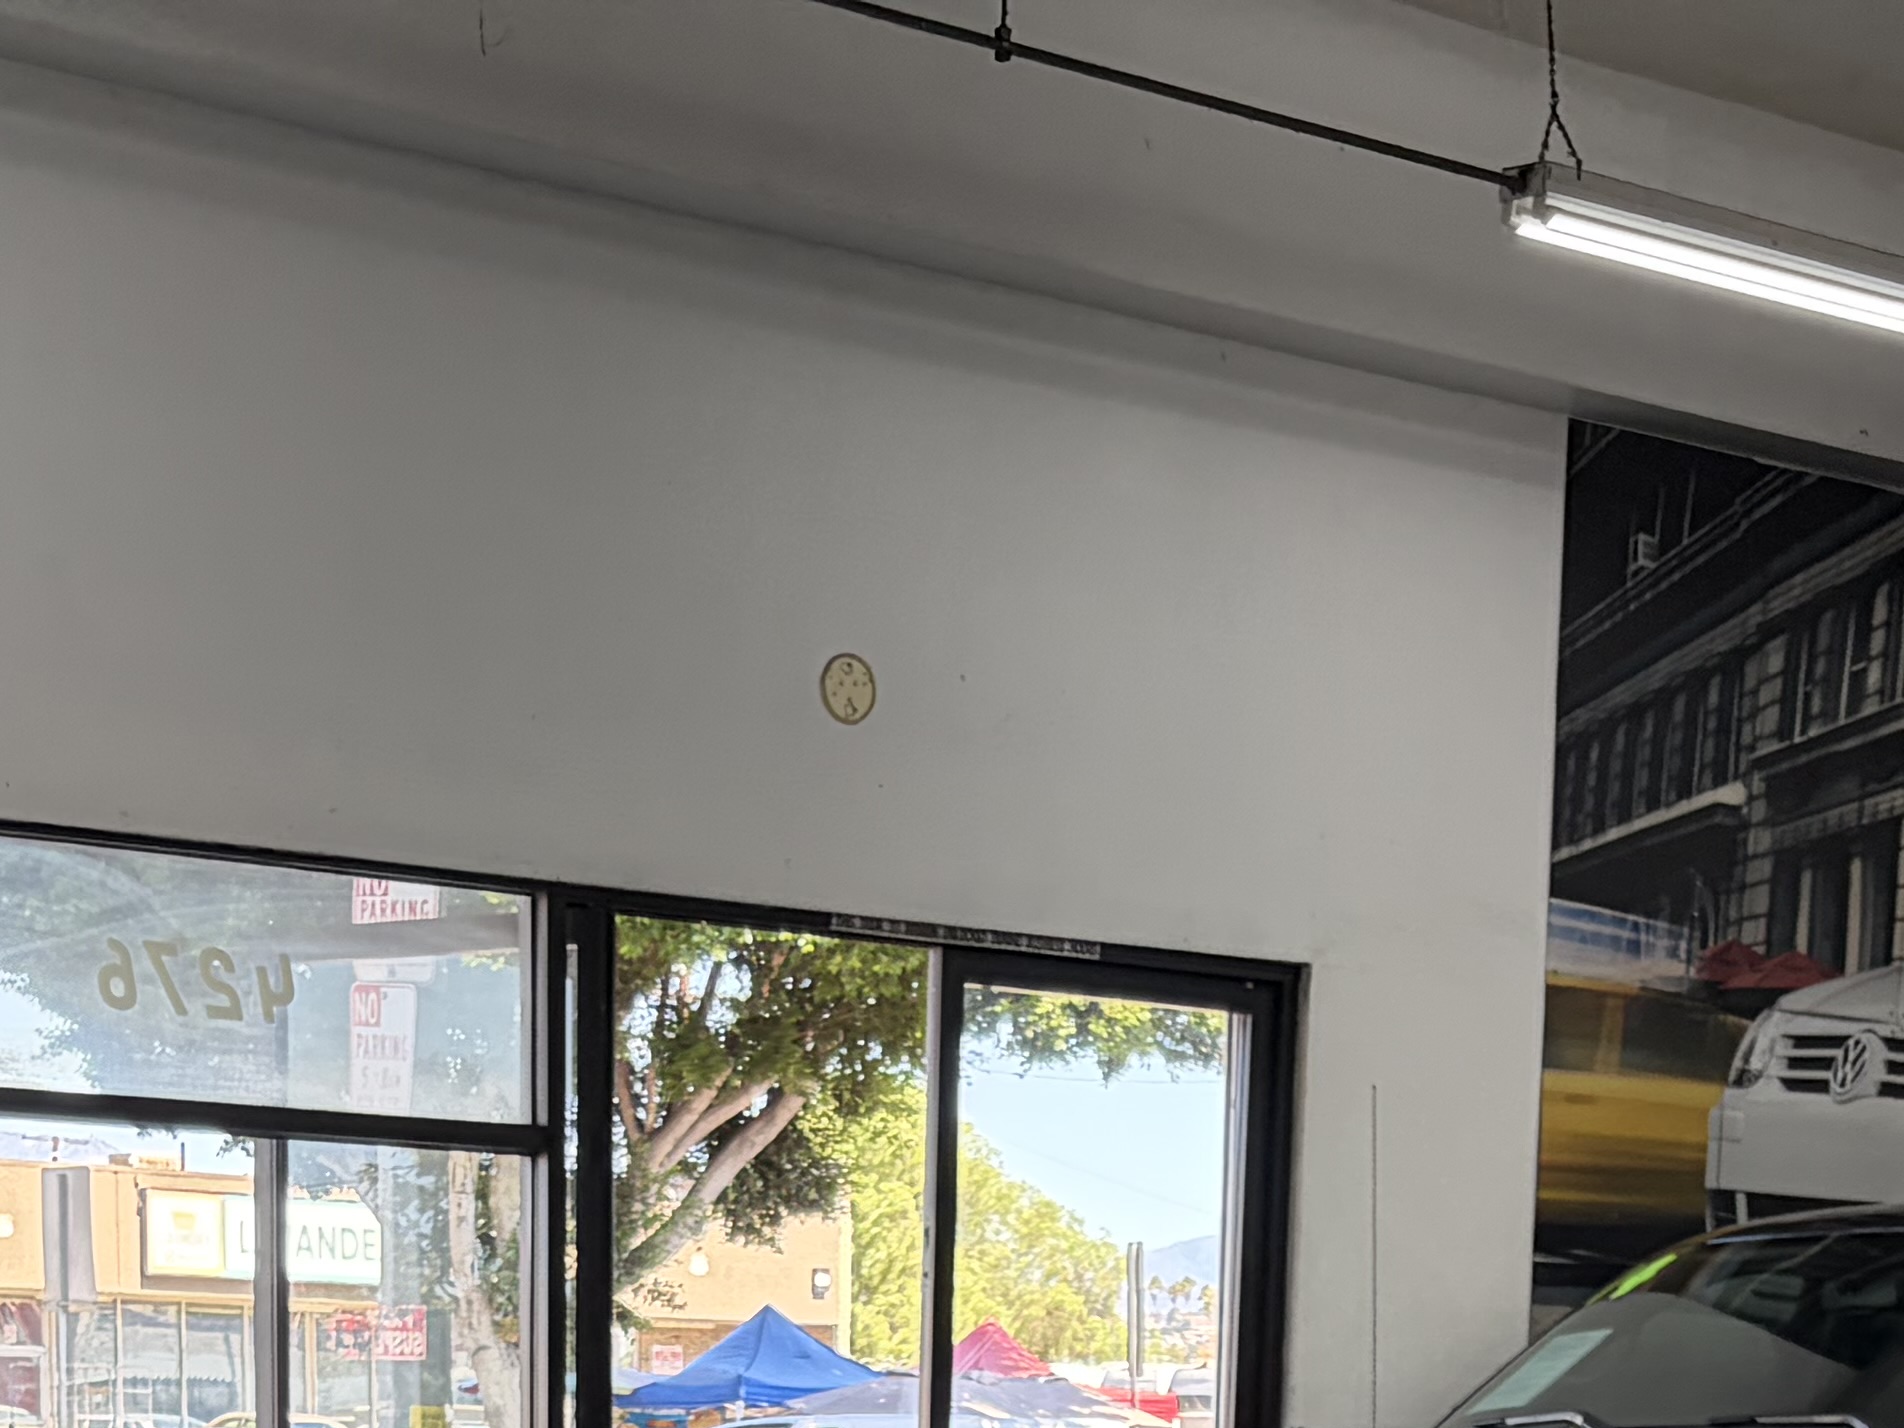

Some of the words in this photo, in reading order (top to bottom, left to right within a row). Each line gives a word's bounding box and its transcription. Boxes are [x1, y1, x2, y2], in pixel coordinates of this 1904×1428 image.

[360, 898, 430, 921] PARKING
[353, 991, 378, 1025] NO
[239, 1219, 377, 1262] LANDE
